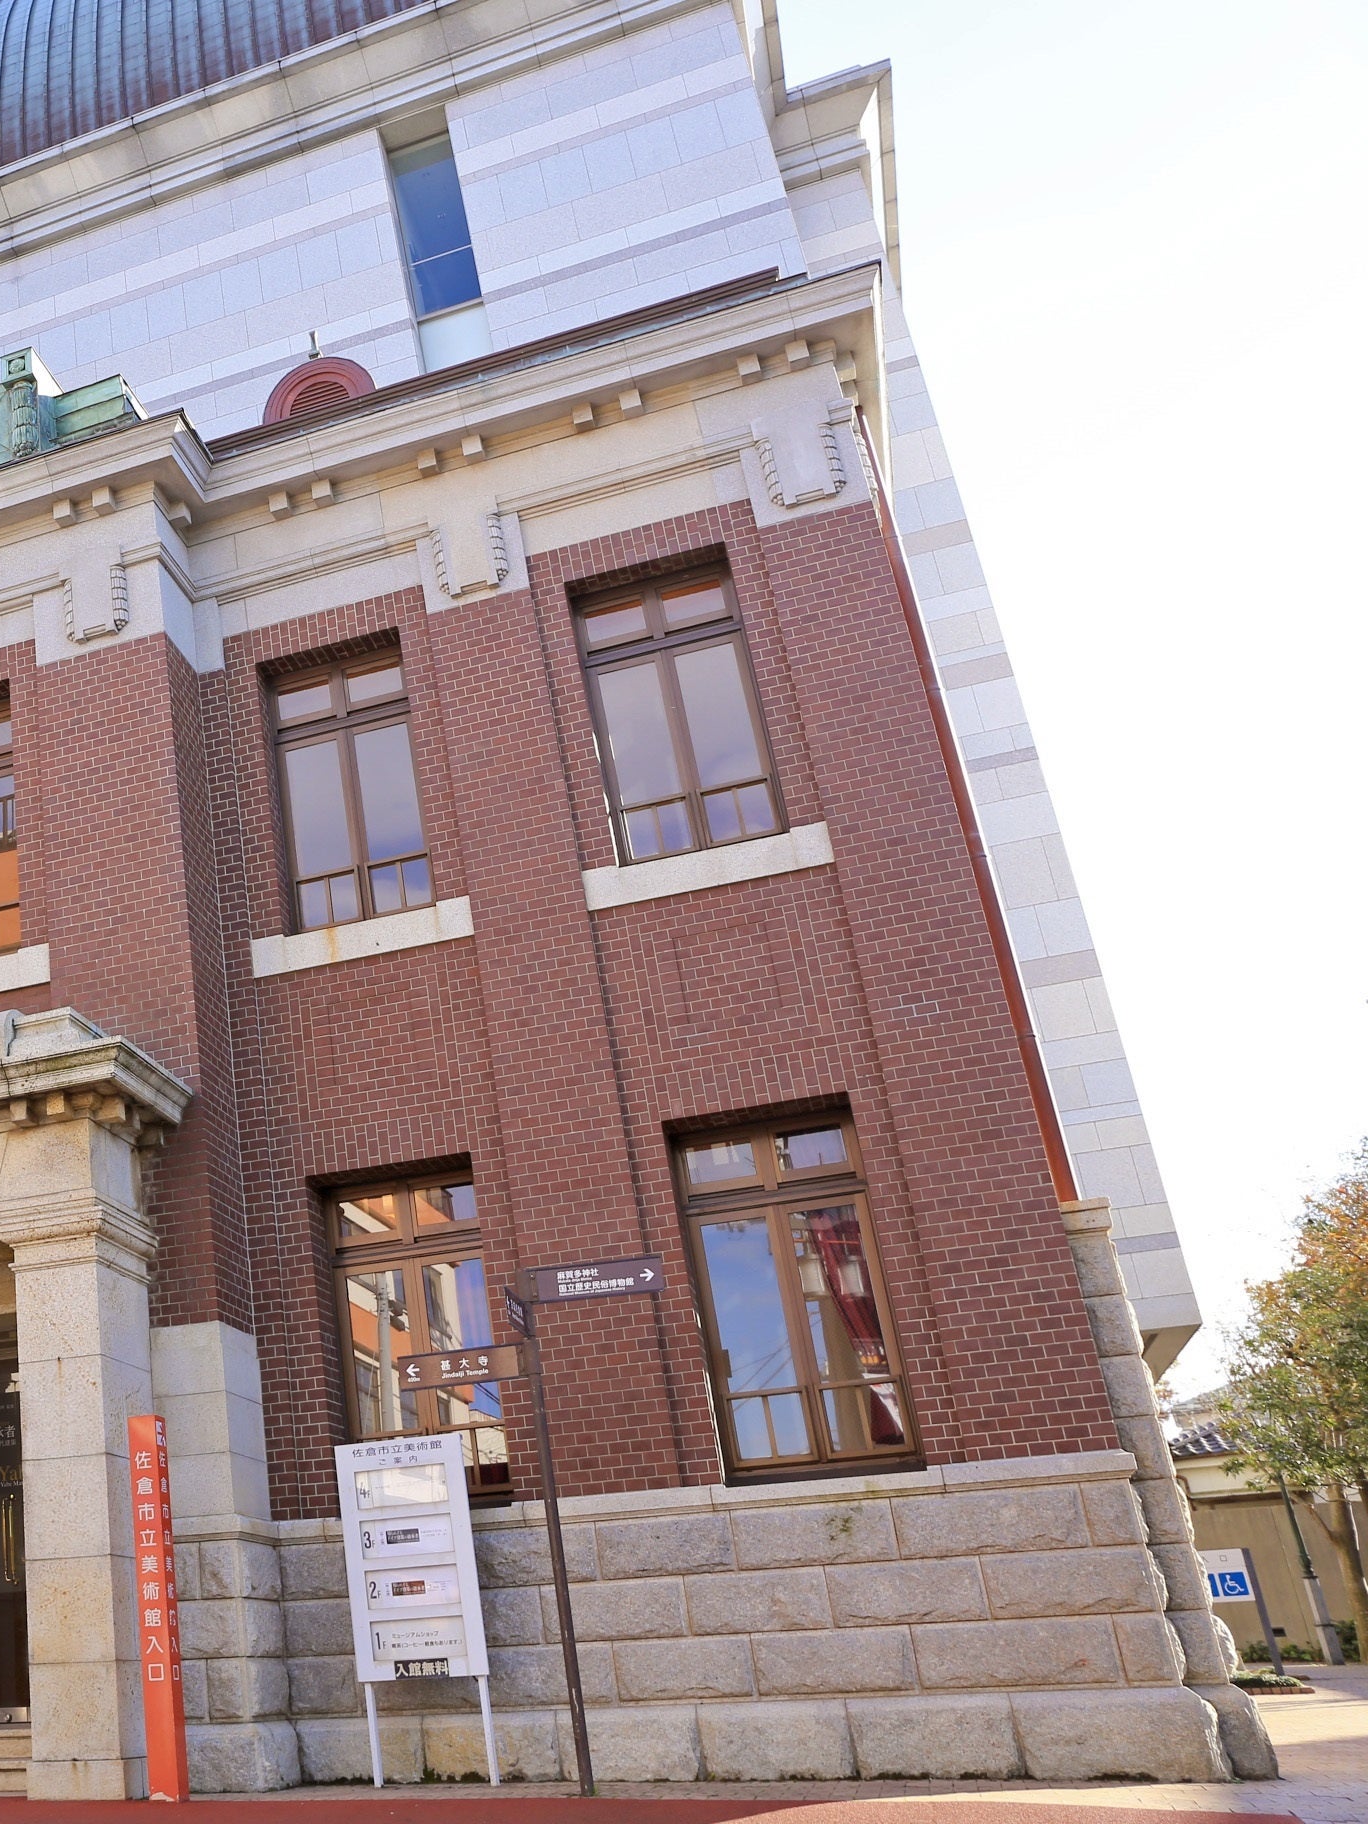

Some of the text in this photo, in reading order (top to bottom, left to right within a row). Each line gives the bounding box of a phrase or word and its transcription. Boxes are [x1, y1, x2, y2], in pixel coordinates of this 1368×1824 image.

[557, 1268, 599, 1280] 麻賀多神社
[558, 1277, 634, 1293] 国立歴史民俗博物館
[440, 1355, 489, 1371] 甚大寺
[441, 1368, 489, 1379] Jindaiji Temple
[352, 1440, 443, 1458] 佐倉市立美術館
[378, 1455, 418, 1466] ご案内
[363, 1531, 376, 1549] 3F
[134, 1451, 165, 1681] 佐倉市立美術館入口
[159, 1451, 180, 1681] 佐倉市立美術館入口
[369, 1581, 382, 1599] 2F
[375, 1631, 386, 1650] 1F
[392, 1630, 439, 1639] ミュージアムショップ
[396, 1660, 448, 1677] 入館無料
